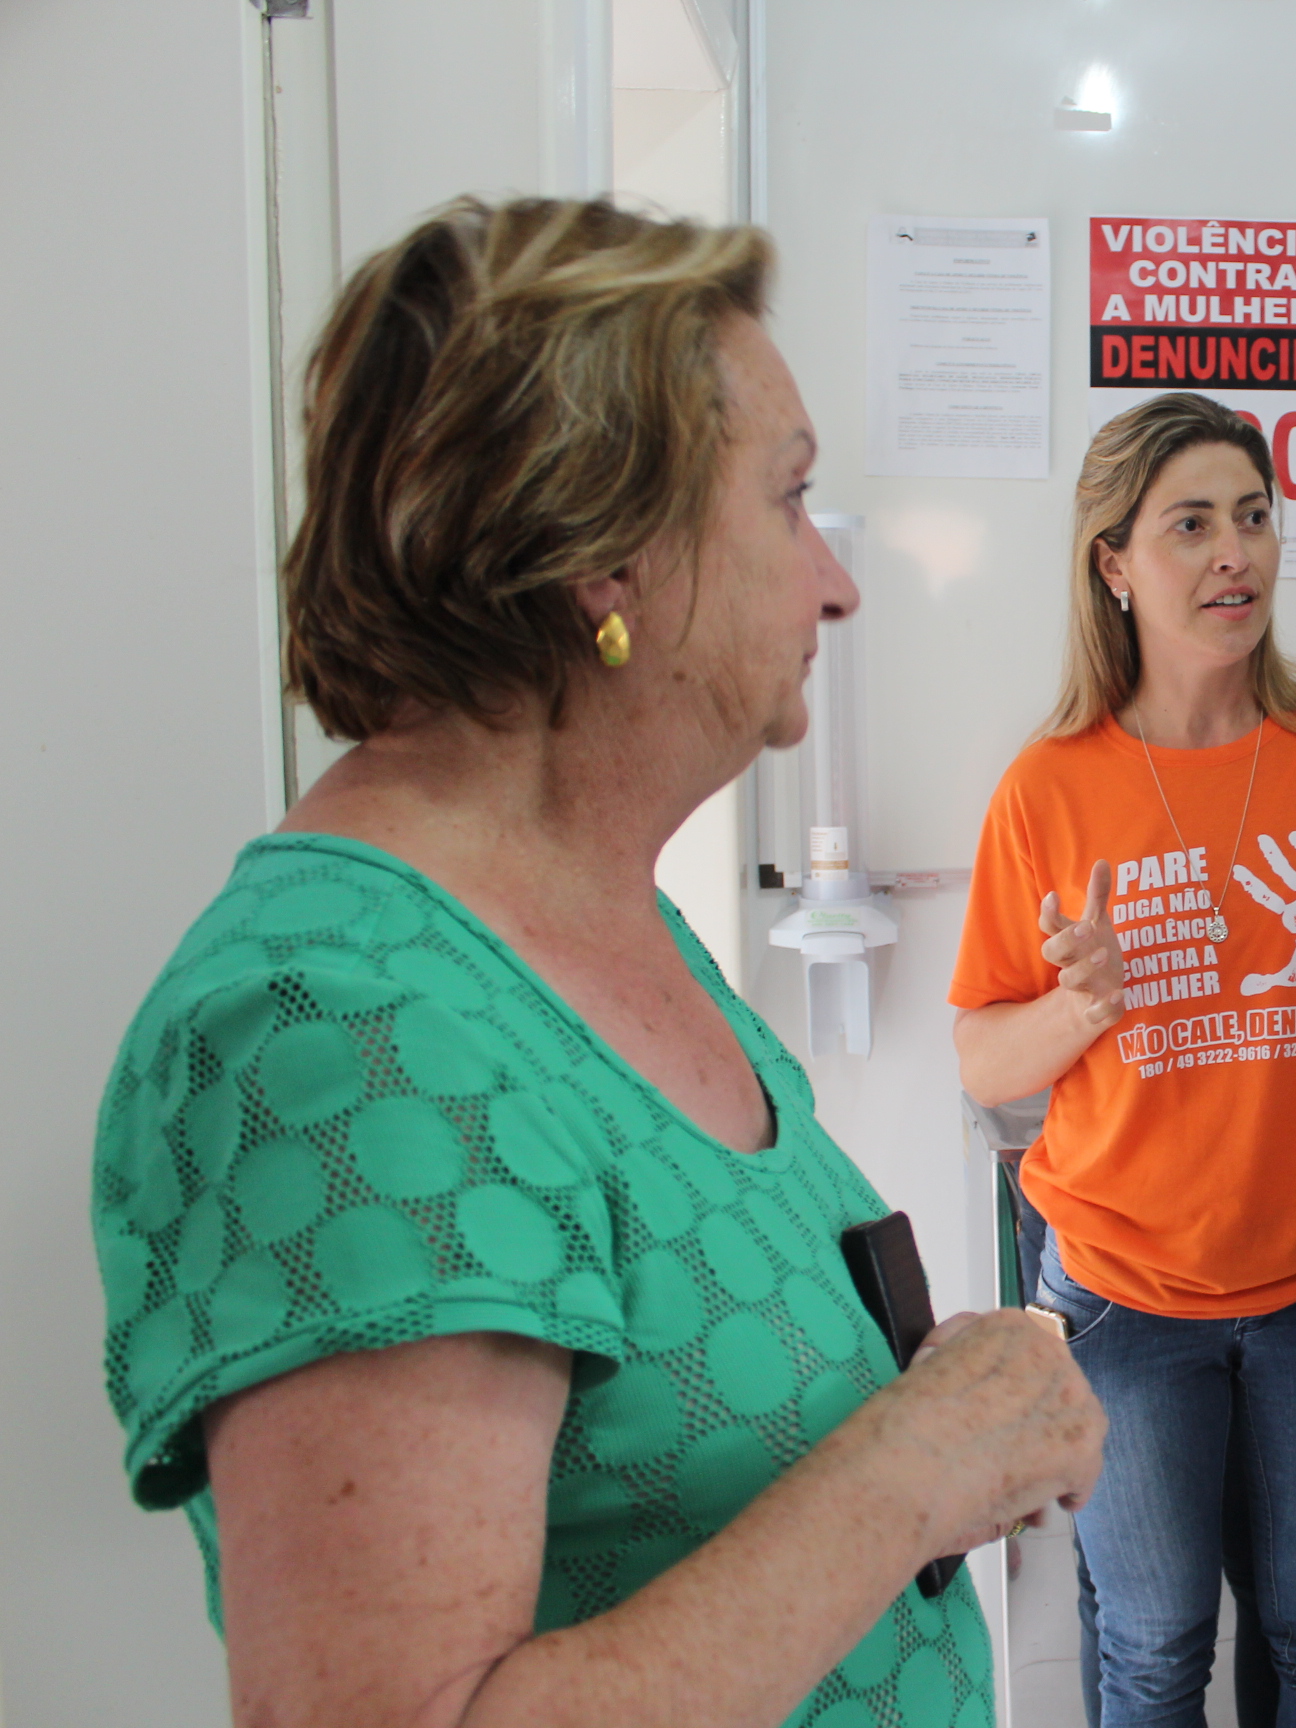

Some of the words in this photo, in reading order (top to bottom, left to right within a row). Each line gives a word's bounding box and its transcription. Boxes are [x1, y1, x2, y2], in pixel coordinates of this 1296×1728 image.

[1101, 294, 1131, 322] A
[1116, 846, 1209, 896] PARE
[1113, 897, 1165, 925] DIGA
[1170, 888, 1212, 912] NÃO
[1204, 945, 1218, 965] A
[1123, 971, 1221, 1011] MULHER
[1117, 1023, 1167, 1063] NÃO
[1169, 1011, 1245, 1051] CALE,
[1138, 1060, 1164, 1079] 180
[1167, 1058, 1174, 1072] /
[1177, 1053, 1194, 1069] 49
[1197, 1045, 1271, 1065] 3222-9616
[1274, 1044, 1281, 1059] /
